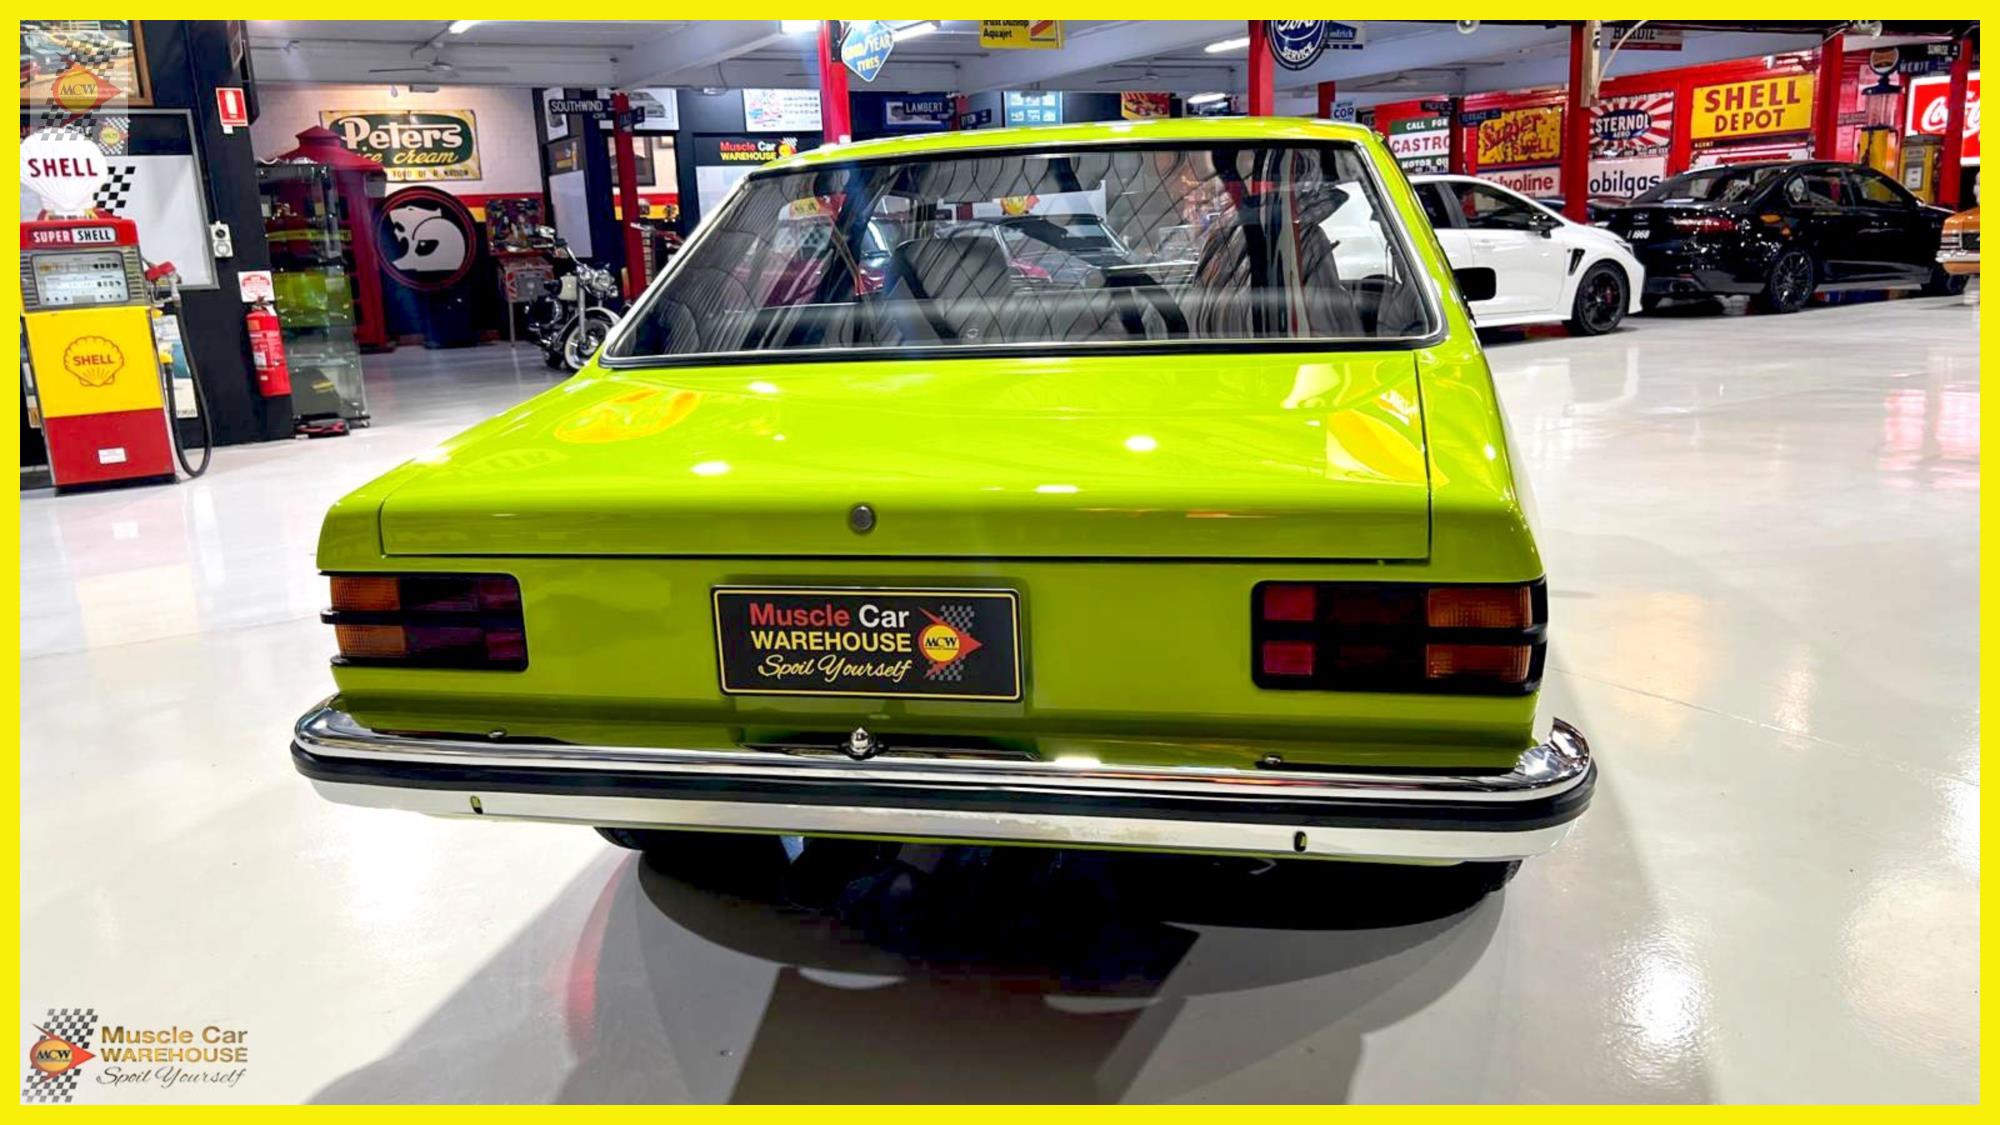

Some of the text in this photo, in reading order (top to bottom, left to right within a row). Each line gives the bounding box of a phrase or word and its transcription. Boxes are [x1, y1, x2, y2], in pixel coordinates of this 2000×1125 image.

[1281, 41, 1315, 61] SERVICE
[857, 56, 880, 72] TYRES
[550, 99, 603, 112] SOUTHWIND
[1704, 81, 1801, 113] SHELL
[905, 102, 943, 113] LAMBERT
[1406, 119, 1449, 130] CALL FOR
[1595, 112, 1650, 133] STERNOL
[1714, 109, 1786, 133] DEPOT
[339, 115, 463, 150] Peters
[720, 140, 776, 151] Muscle Car
[1391, 135, 1449, 153] CASTRO
[393, 149, 459, 164] cream
[720, 152, 777, 160] WAREHOUSE
[1402, 159, 1431, 169] MOTOR
[28, 158, 98, 177] SHELL
[1486, 174, 1554, 192] voline
[1589, 170, 1660, 199] obilgas
[32, 229, 111, 243] SUPER SHELL
[73, 354, 115, 366] SHELL
[750, 603, 909, 628] Muscle Car
[750, 631, 912, 652] WAREHOUSE
[758, 654, 912, 683] Spoil Yourself
